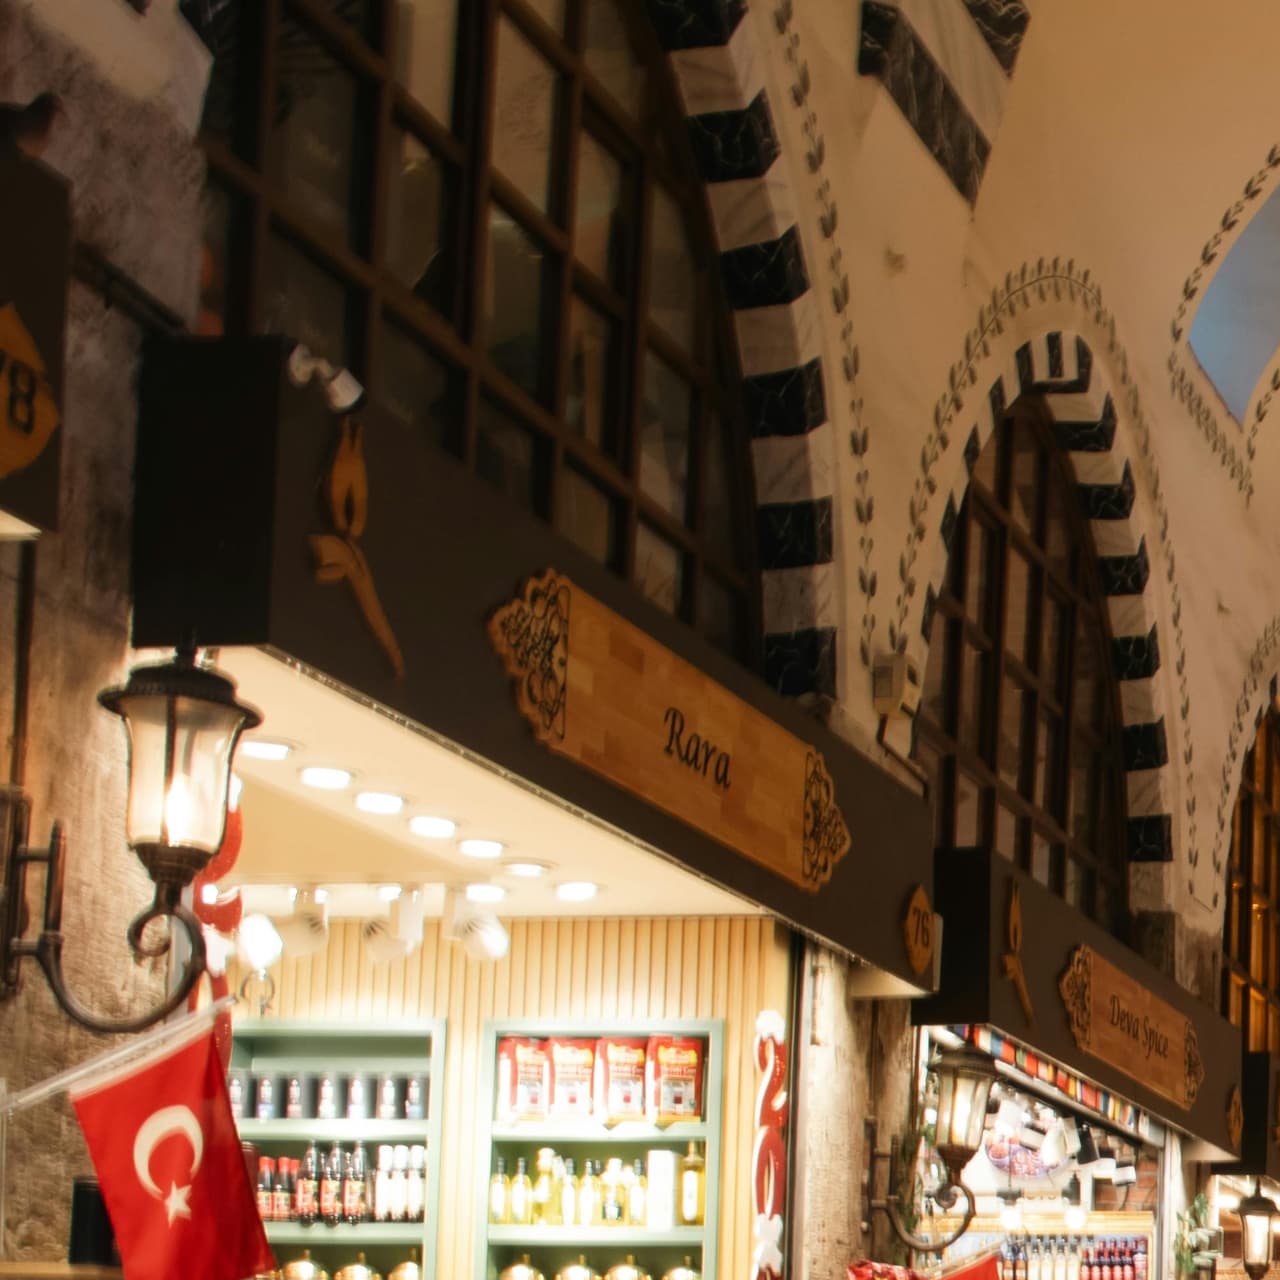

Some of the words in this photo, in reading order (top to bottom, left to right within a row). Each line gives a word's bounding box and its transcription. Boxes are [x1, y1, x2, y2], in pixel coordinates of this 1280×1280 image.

[0, 352, 35, 434] 8
[664, 706, 731, 790] Rara
[912, 908, 930, 947] 76
[1110, 994, 1139, 1041] Deva
[1142, 1015, 1169, 1061] Spice
